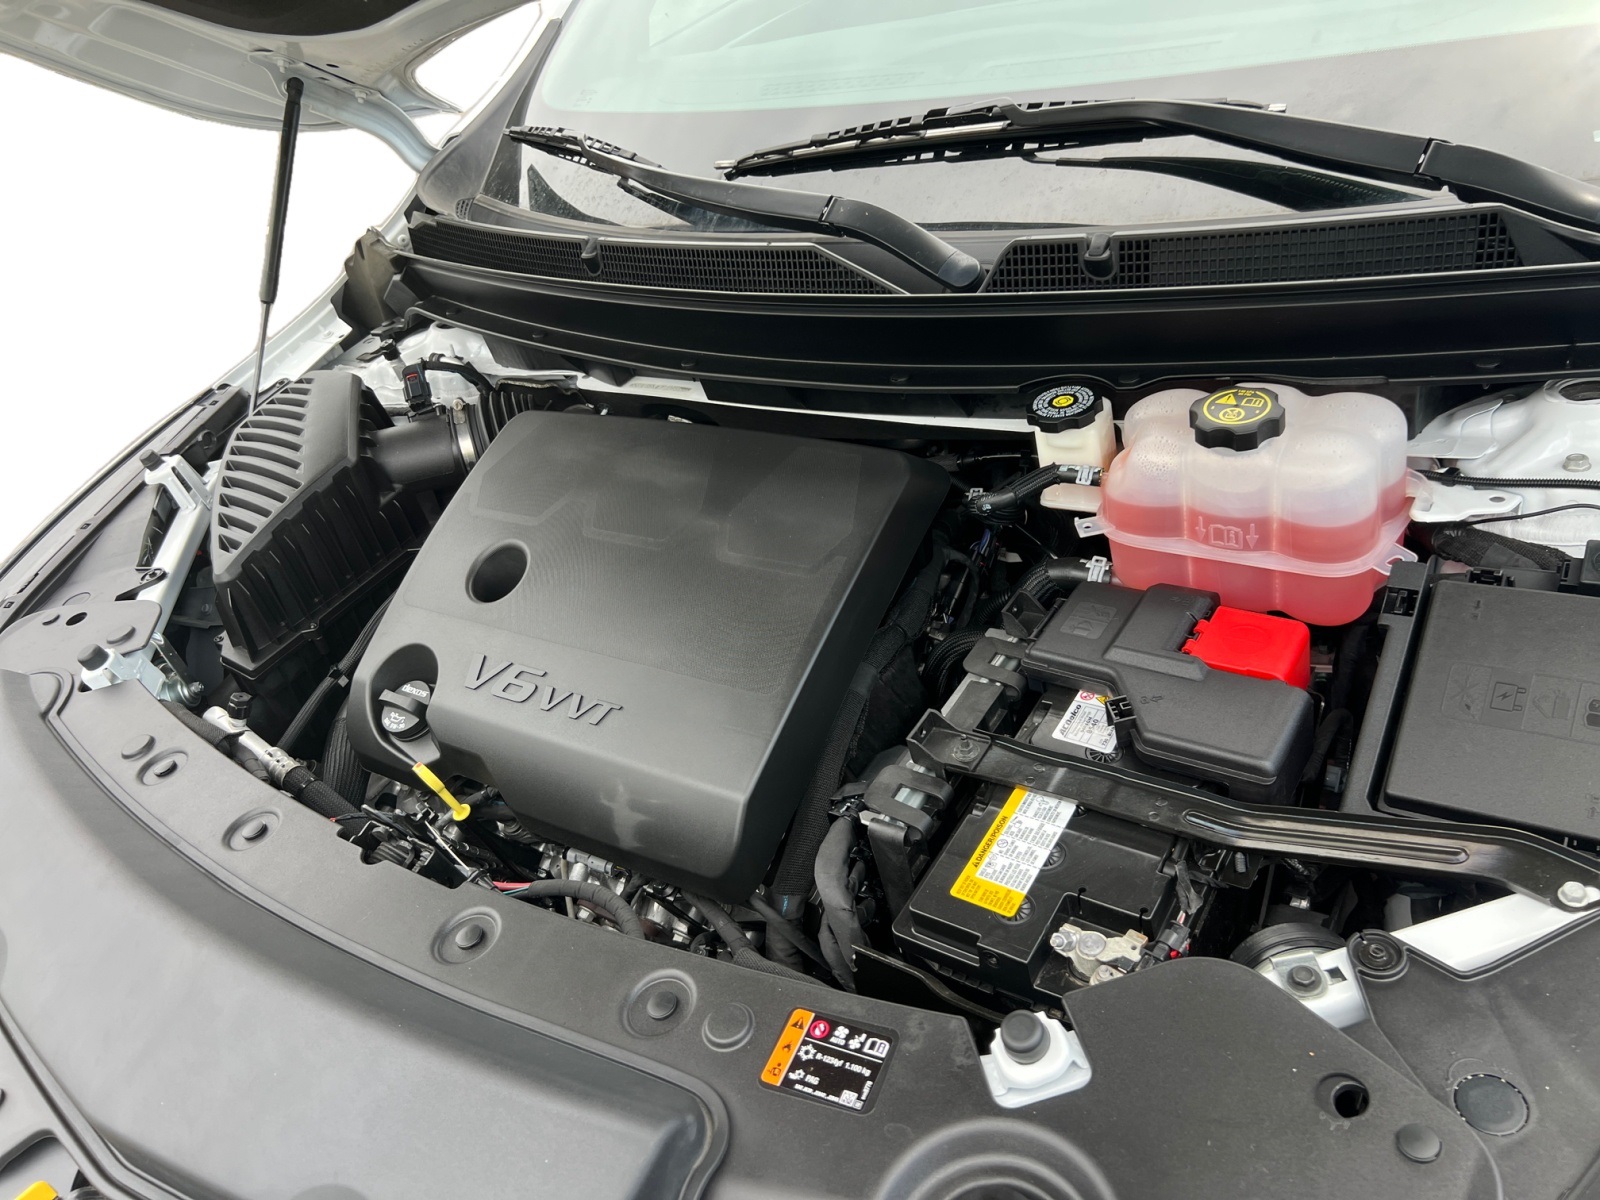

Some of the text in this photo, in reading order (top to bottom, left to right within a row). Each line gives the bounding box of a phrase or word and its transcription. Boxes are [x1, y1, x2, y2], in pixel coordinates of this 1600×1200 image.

[401, 684, 430, 698] dexos
[464, 652, 624, 726] V6 VVT
[1060, 704, 1082, 736] ACDelco
[975, 815, 1009, 864] DANGER/POISON
[829, 1036, 846, 1046] AUTO
[861, 1067, 872, 1077] kg
